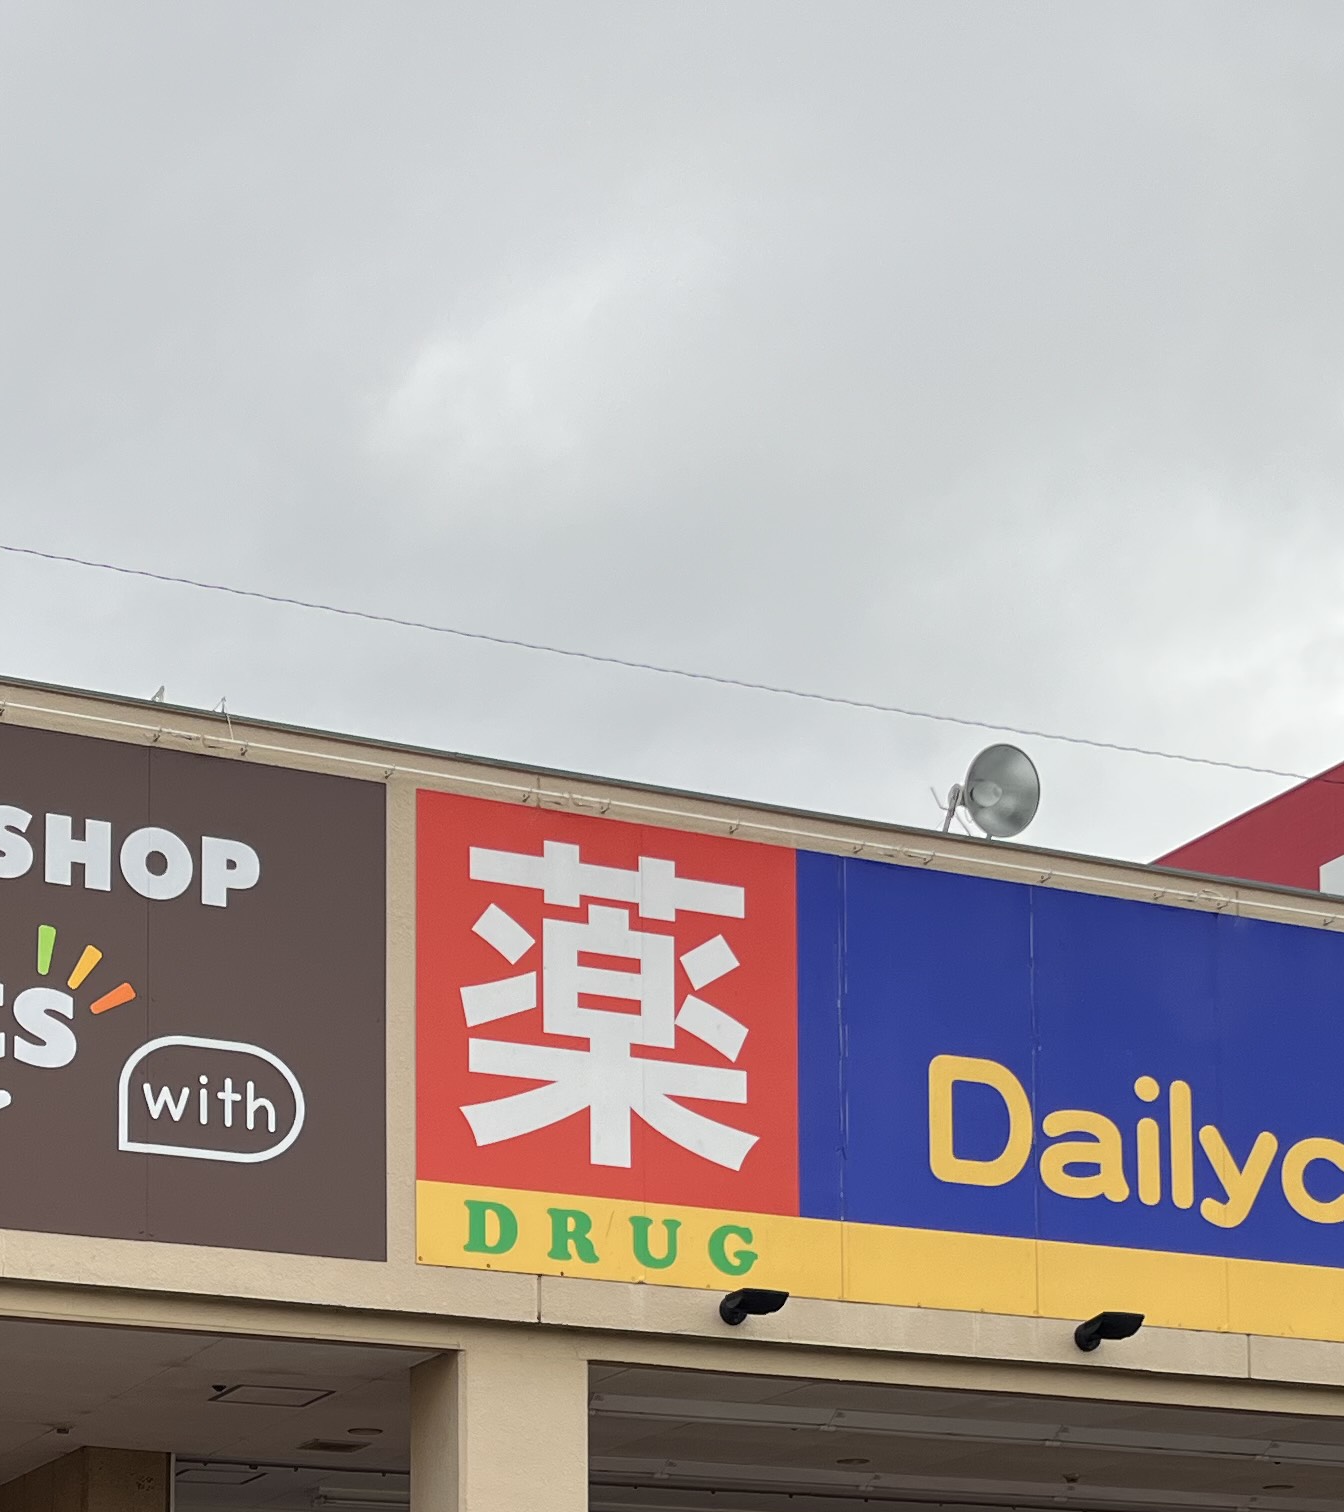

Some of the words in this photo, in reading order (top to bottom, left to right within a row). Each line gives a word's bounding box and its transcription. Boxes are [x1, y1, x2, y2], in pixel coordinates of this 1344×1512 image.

[459, 840, 760, 1172] 薬
[143, 1074, 277, 1134] with
[463, 1199, 759, 1277] DRUG
